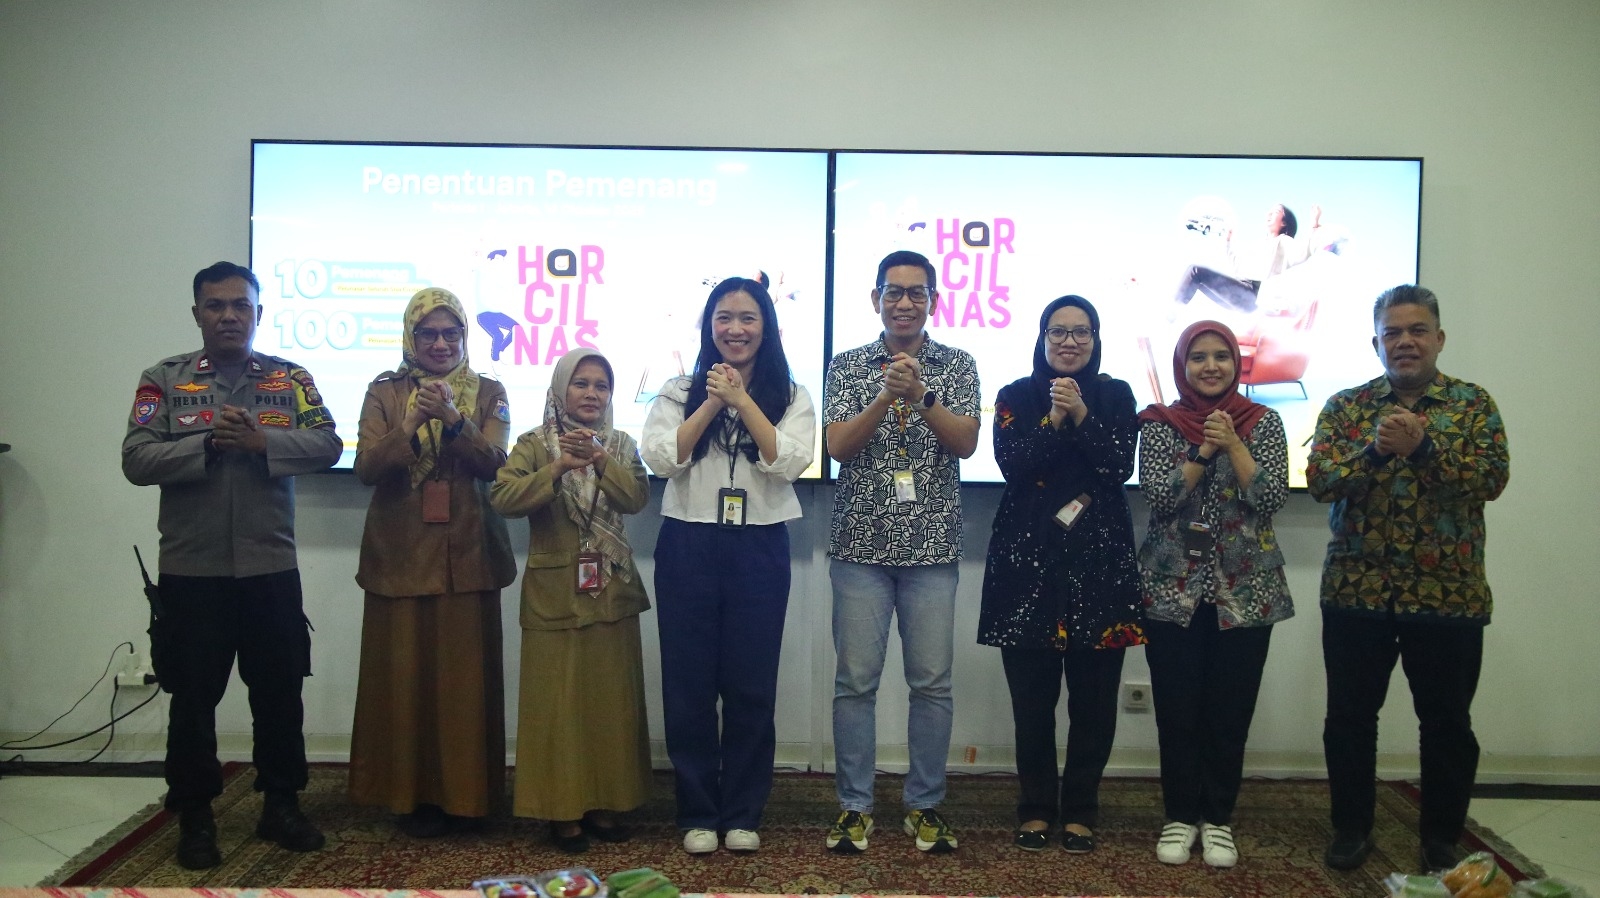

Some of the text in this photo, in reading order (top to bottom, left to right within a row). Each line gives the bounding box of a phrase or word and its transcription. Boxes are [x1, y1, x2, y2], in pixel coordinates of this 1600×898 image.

[362, 166, 718, 206] Penentuan Pemenang
[274, 258, 328, 299] 10
[941, 250, 1010, 293] CIL
[523, 280, 599, 327] CIL
[932, 291, 1012, 329] NAS
[273, 309, 358, 350] 100
[173, 395, 214, 408] HERRI
